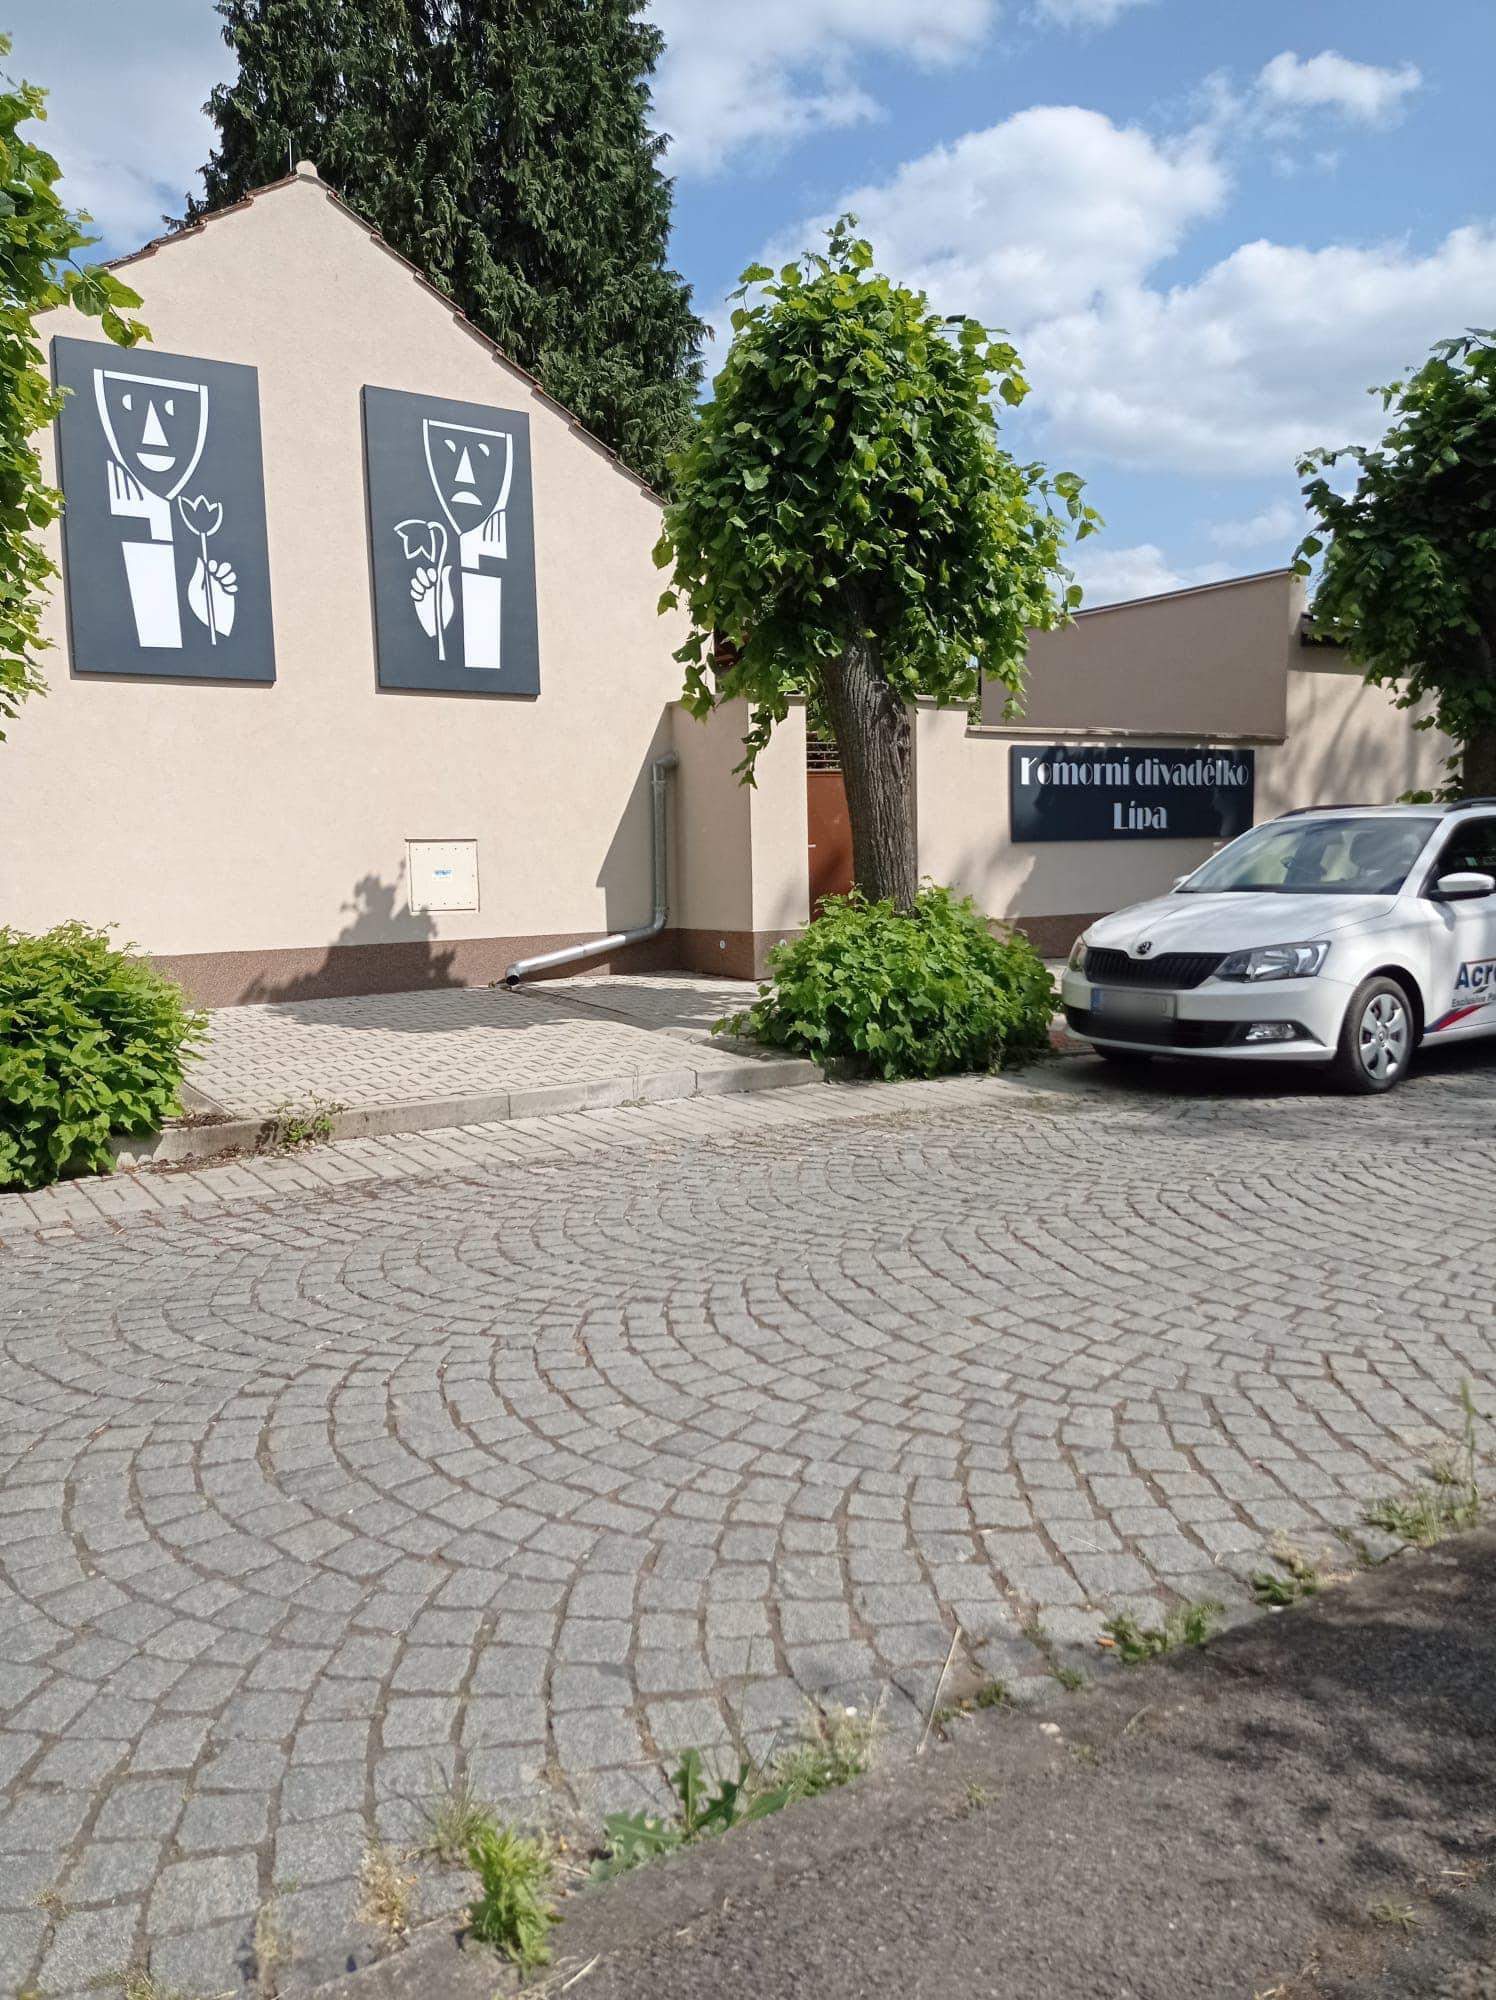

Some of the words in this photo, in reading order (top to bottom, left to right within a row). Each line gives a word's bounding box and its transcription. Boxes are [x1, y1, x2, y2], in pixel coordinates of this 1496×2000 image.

[1135, 757, 1249, 786] divadélko
[1113, 800, 1168, 830] Lípa
[1453, 962, 1496, 990] Acr
